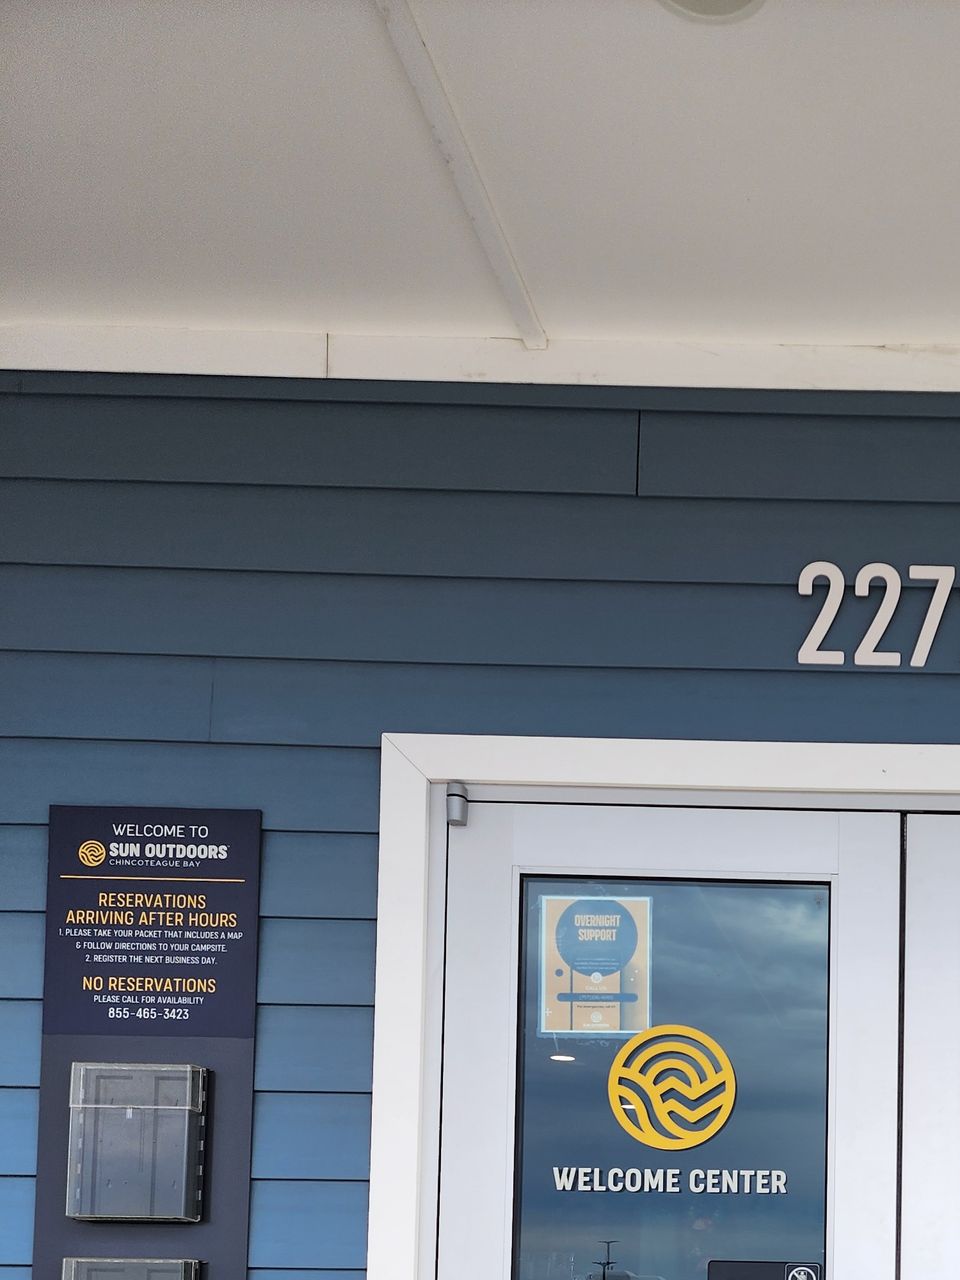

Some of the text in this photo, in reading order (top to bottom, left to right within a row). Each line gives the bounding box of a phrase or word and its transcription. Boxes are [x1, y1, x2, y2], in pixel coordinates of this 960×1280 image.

[113, 824, 208, 838] WELCOME TO
[109, 843, 140, 857] SUN
[109, 859, 180, 867] CHINCOTEAGUE
[99, 893, 206, 909] RESERVATIONS
[66, 911, 237, 927] ARRIVING AFTER HOURS
[575, 915, 621, 927] OVERNIGHT
[65, 929, 91, 937] PLEASE
[93, 929, 111, 937] TAKE
[134, 930, 162, 938] PACKET
[164, 930, 182, 938] THAT
[185, 931, 219, 939] INCLUDES
[227, 932, 243, 940] MAP
[578, 929, 616, 941] SUPPORT
[83, 942, 113, 950] FOLLOW
[115, 942, 156, 950] DIRECTIONS
[158, 943, 168, 951] TO
[170, 943, 189, 951] YOUR
[191, 944, 228, 952] CAMPSITE.
[93, 955, 127, 963] REGISTER
[165, 956, 199, 964] BUSINESS
[83, 977, 216, 993] NO RESERVATIONS
[94, 995, 120, 1003] PLEASE
[122, 995, 139, 1003] CALL
[157, 996, 204, 1004] AVAILABILITY
[109, 1007, 189, 1020] 855-465-3423
[553, 1167, 787, 1194] WELCOME CENTER
